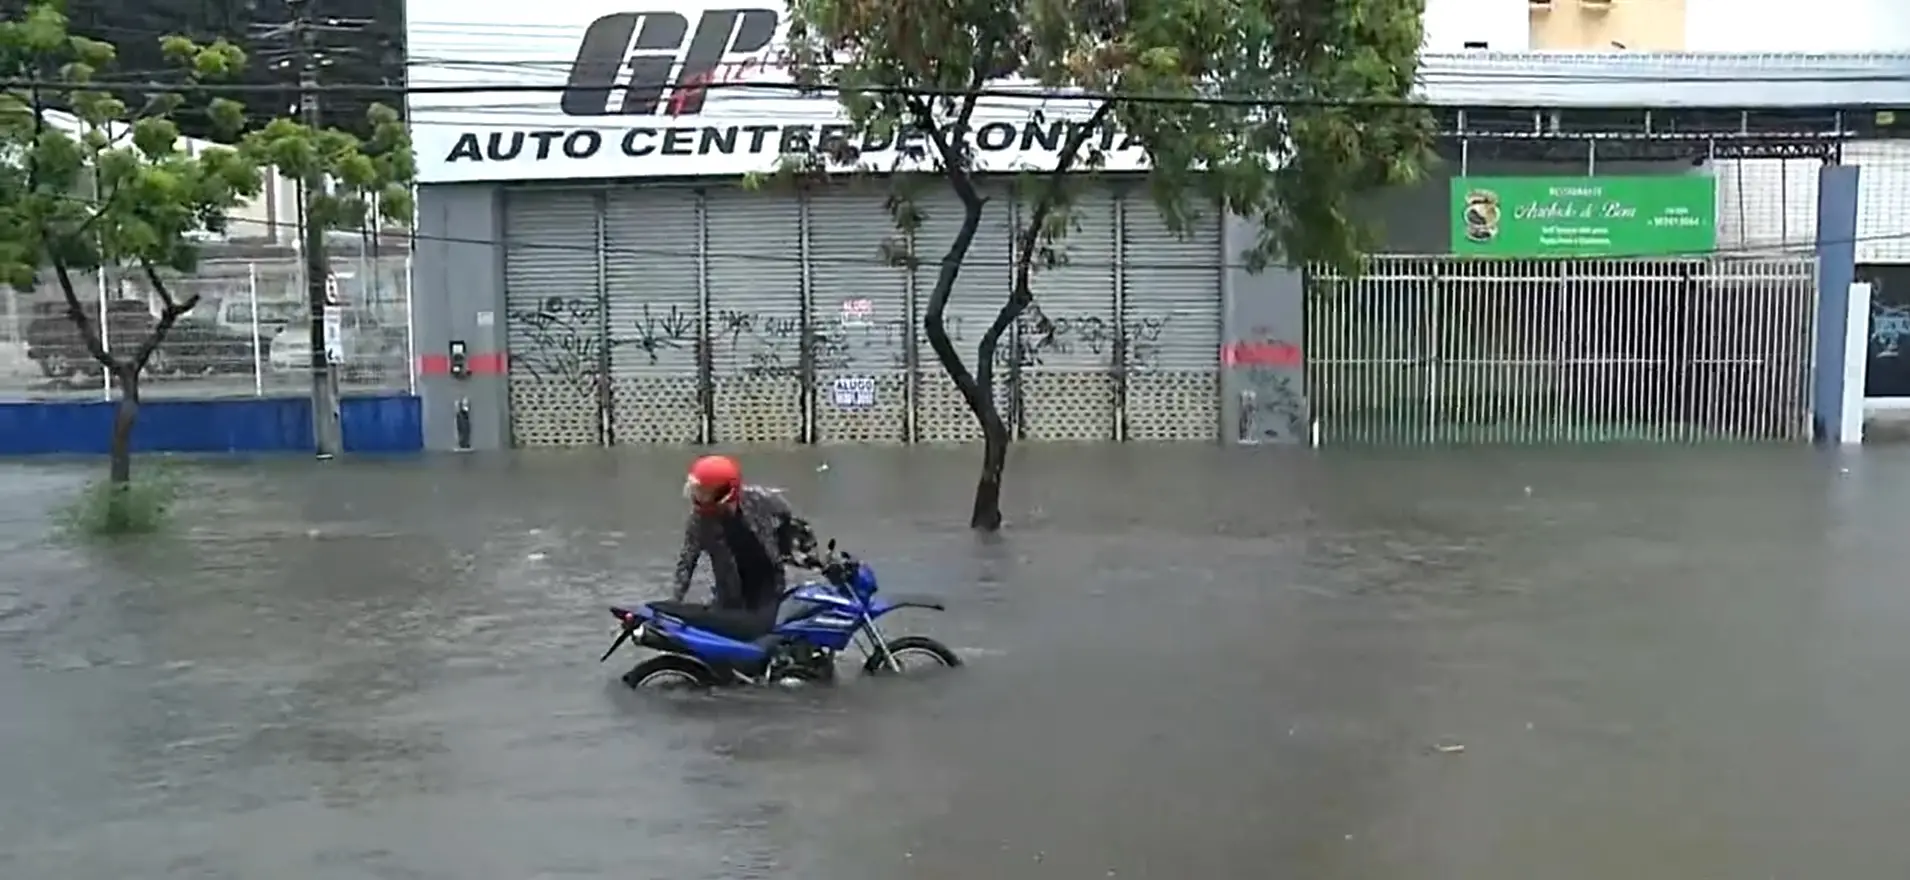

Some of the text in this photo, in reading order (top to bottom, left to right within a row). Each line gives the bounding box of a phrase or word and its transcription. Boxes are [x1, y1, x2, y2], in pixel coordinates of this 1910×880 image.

[561, 8, 779, 117] GP
[445, 129, 603, 162] AUTO
[837, 380, 873, 390] ALUGO
